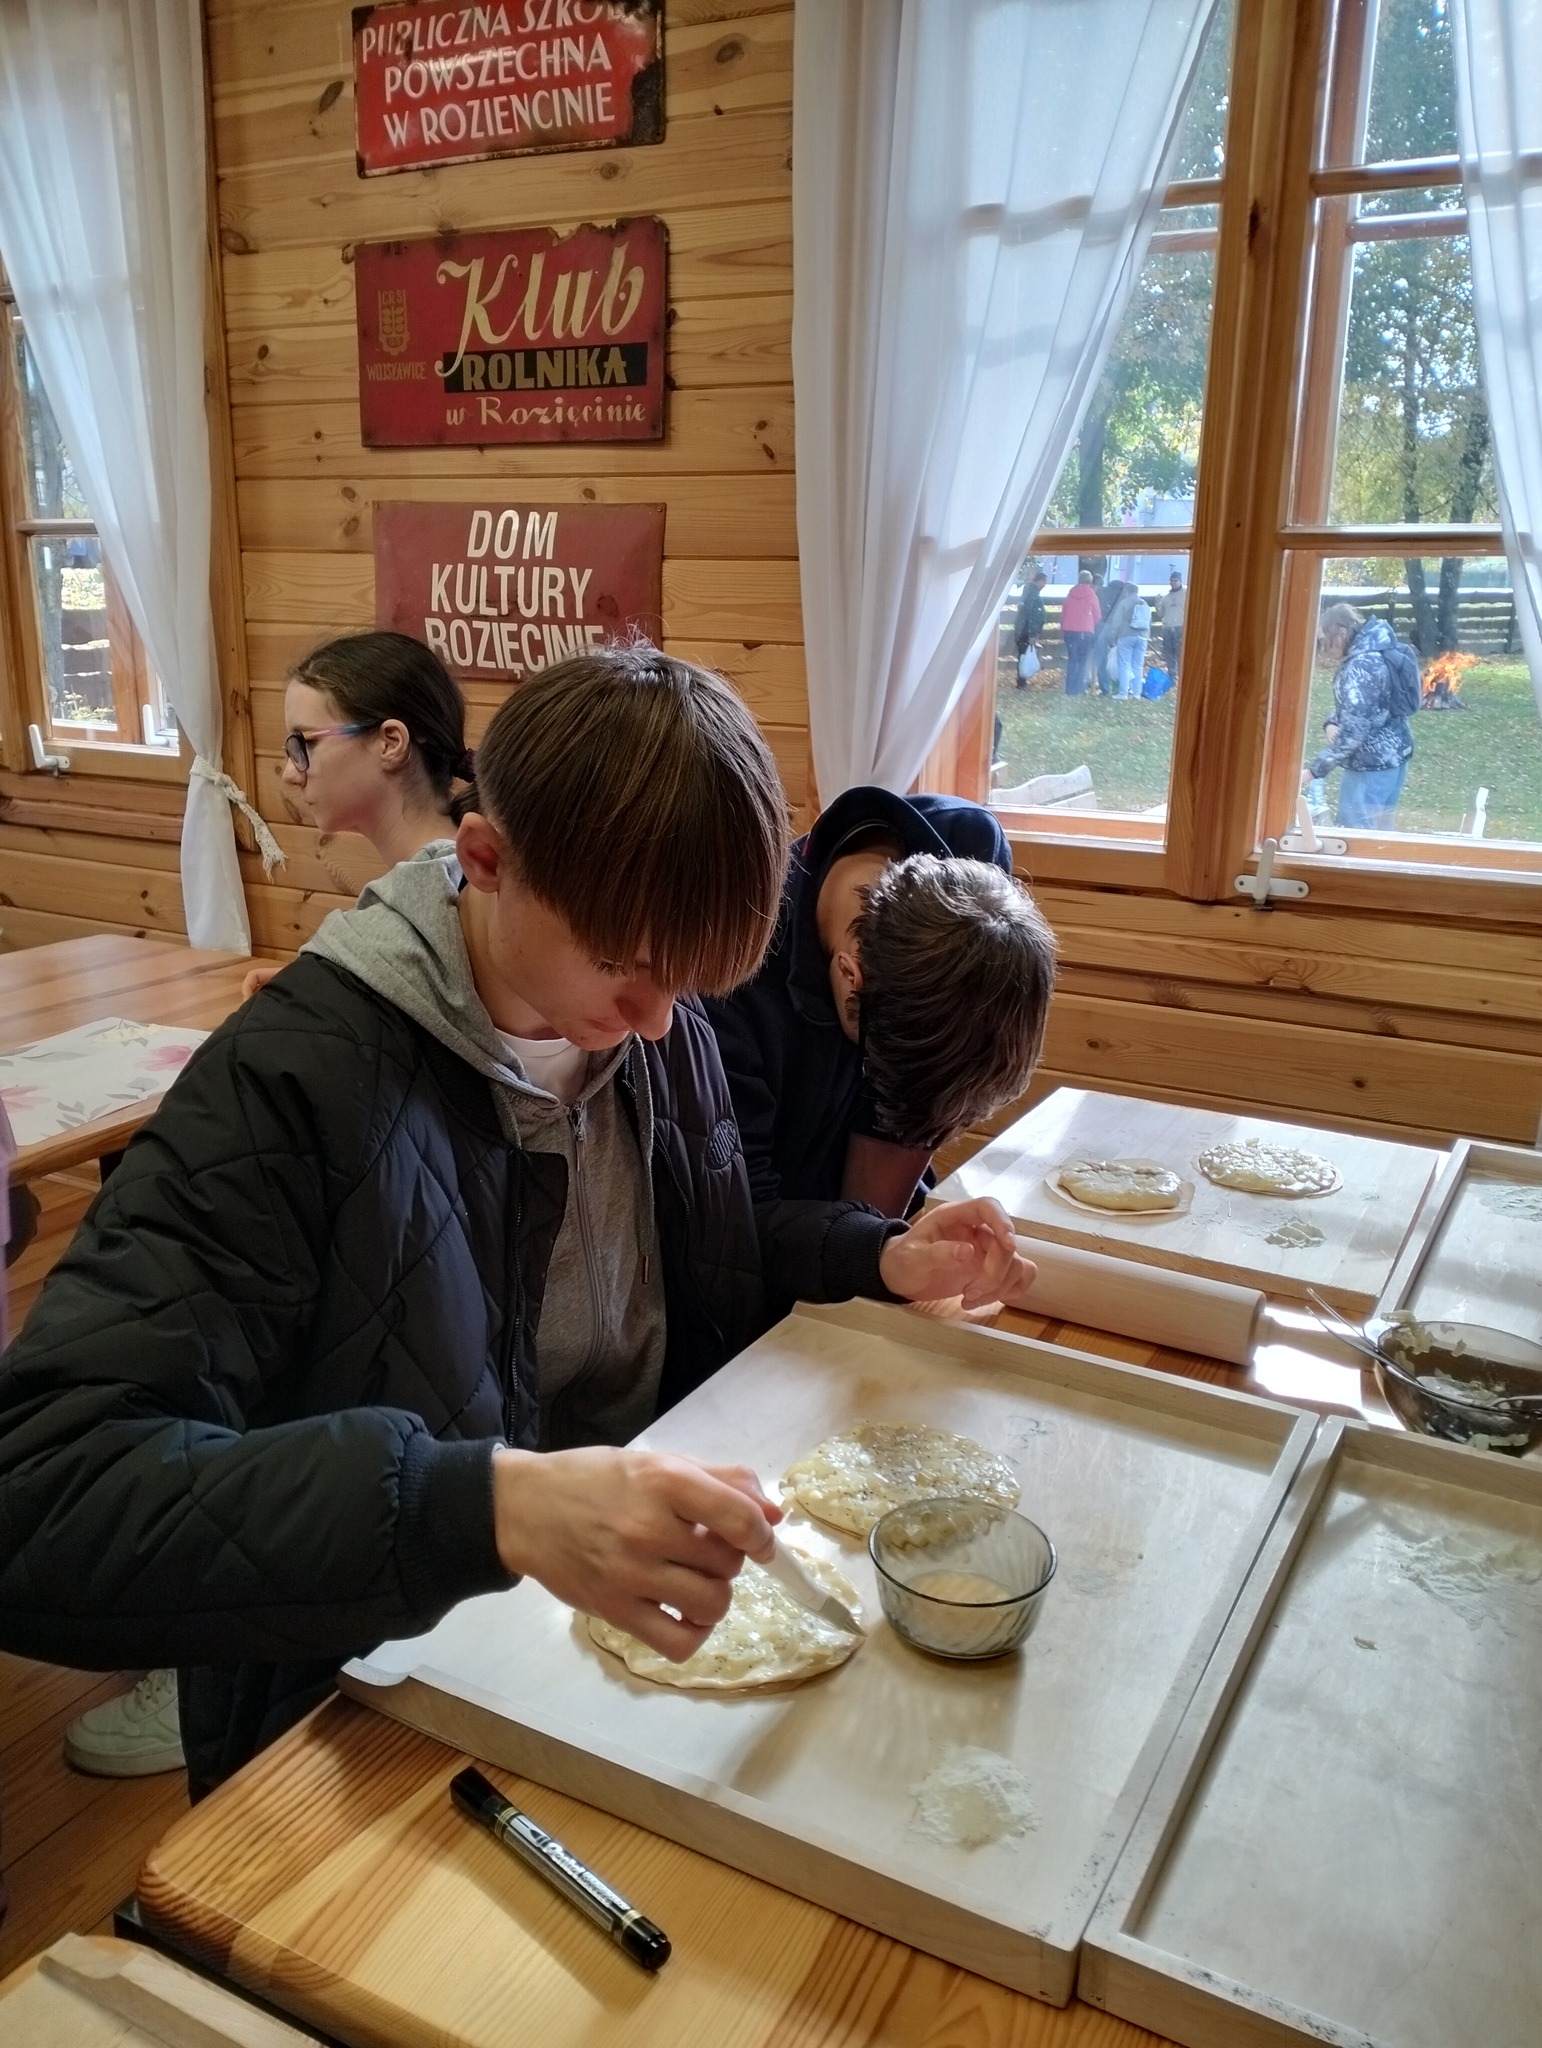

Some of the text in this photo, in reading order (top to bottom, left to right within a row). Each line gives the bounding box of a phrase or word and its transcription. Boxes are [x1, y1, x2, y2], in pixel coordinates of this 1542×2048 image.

[384, 32, 612, 104] POWSZECHNA
[383, 82, 615, 148] W ROZIENCINIE
[434, 240, 645, 377] Klub
[463, 346, 628, 391] ROLNIKA
[476, 395, 646, 428] Rozięcinie
[466, 509, 559, 560] DOM
[431, 563, 593, 619] KULTURY
